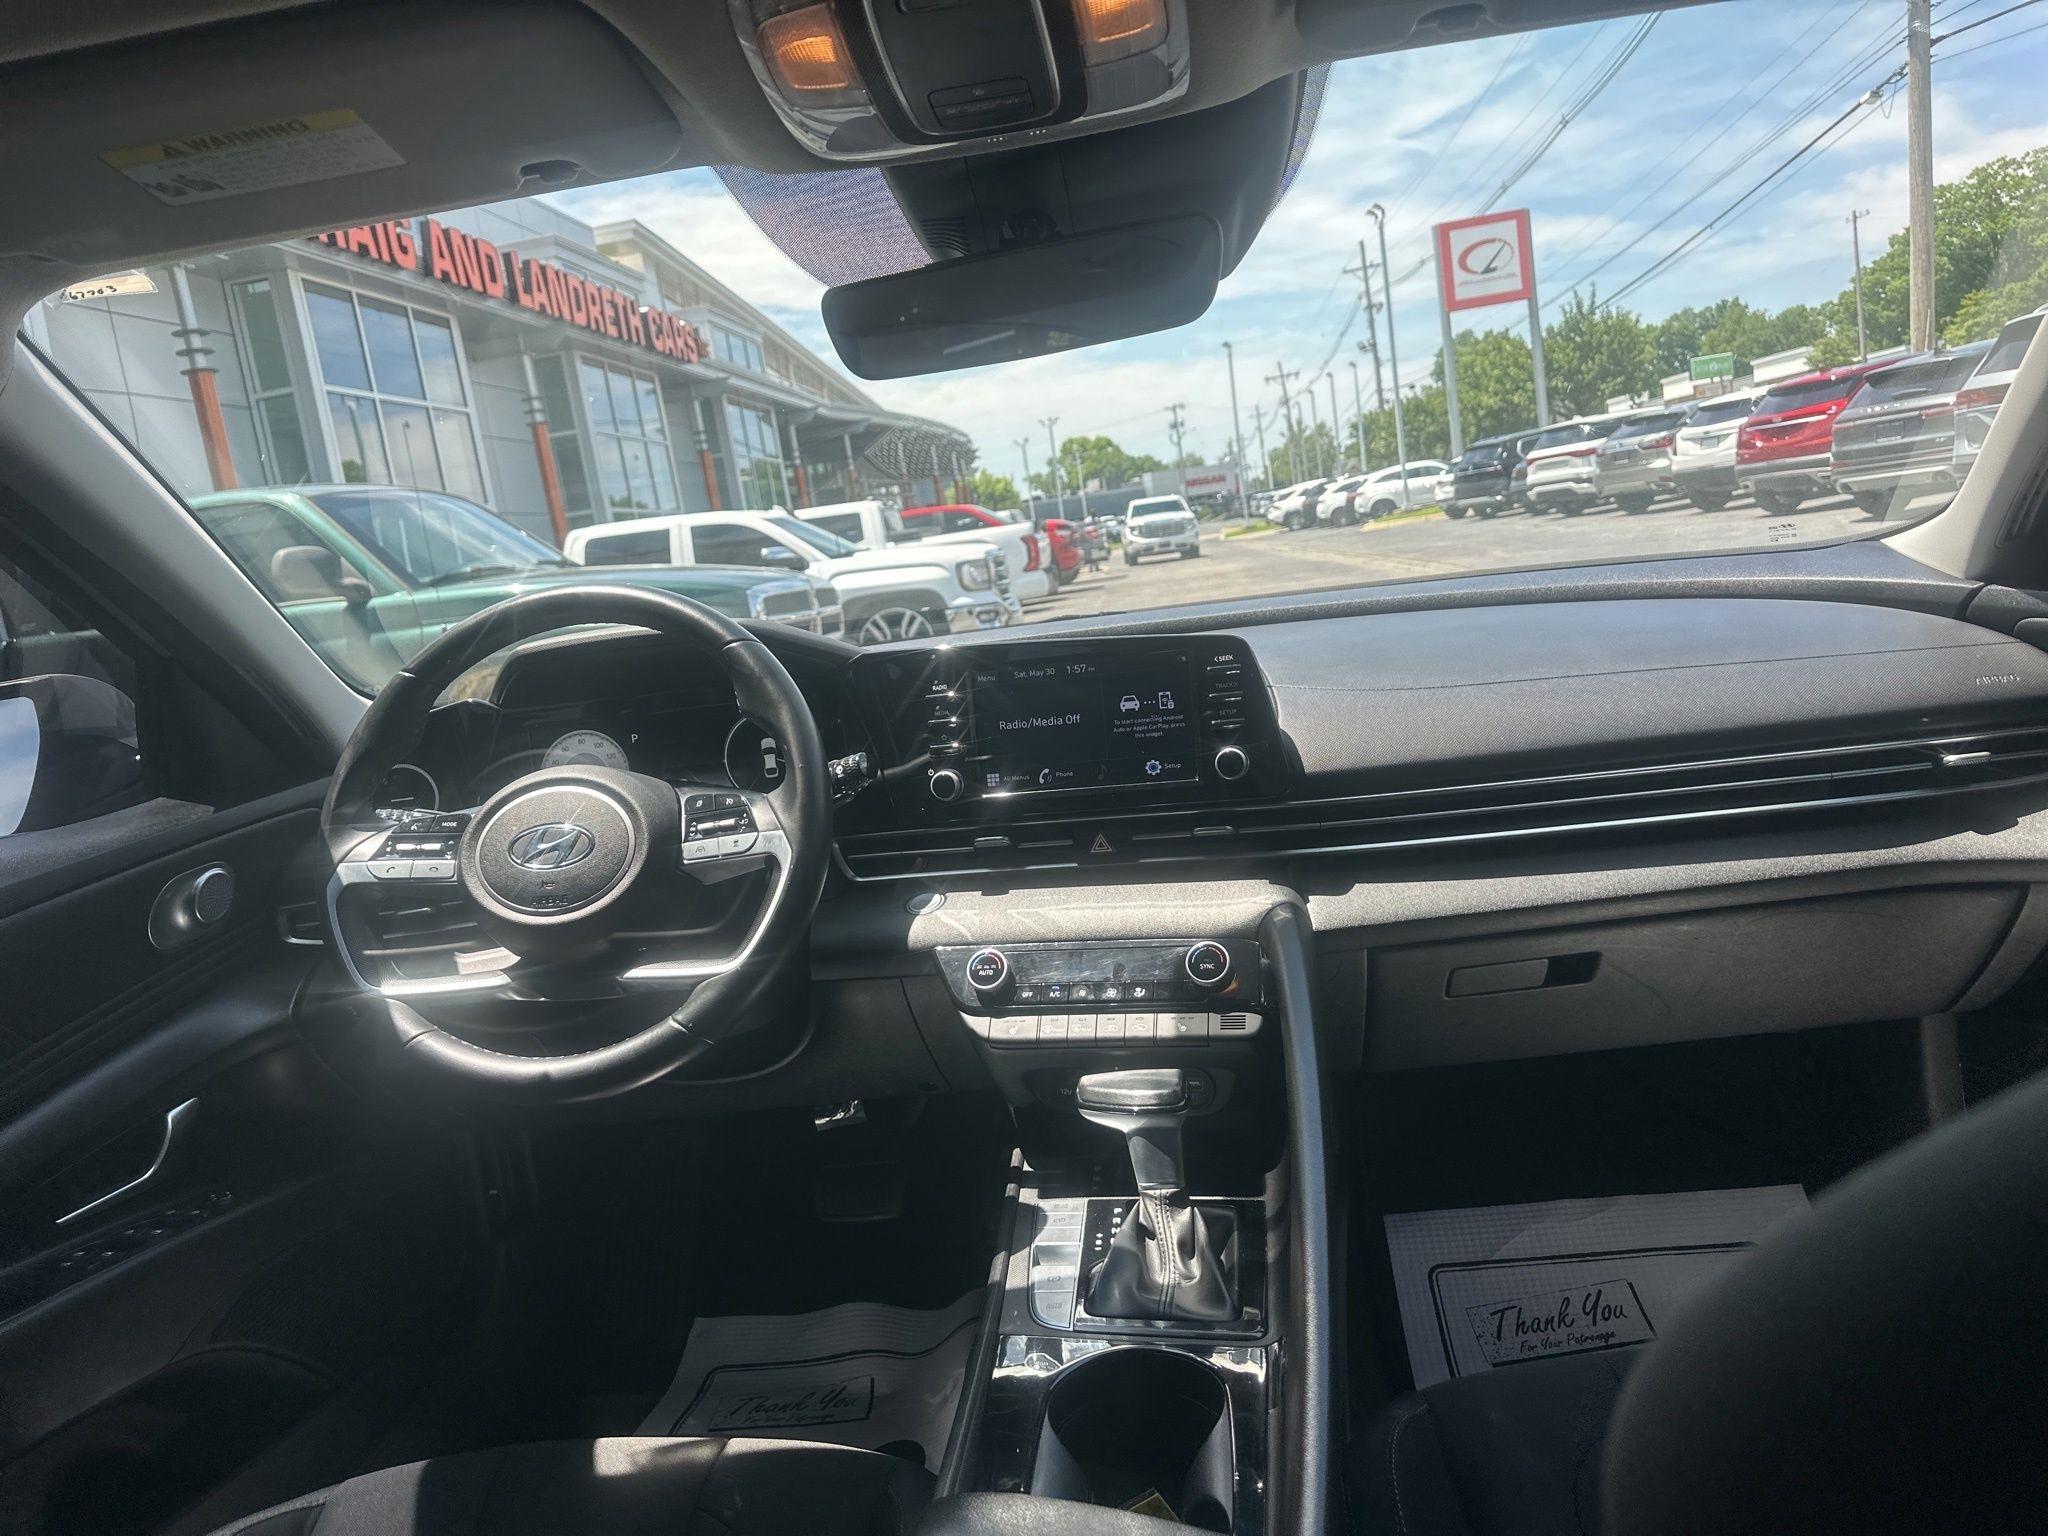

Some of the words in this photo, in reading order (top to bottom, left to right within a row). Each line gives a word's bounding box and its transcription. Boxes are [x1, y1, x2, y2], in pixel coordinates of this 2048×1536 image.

[182, 118, 311, 152] WARNING
[425, 218, 505, 299] AND
[511, 249, 646, 347] LANDRETH
[648, 306, 699, 364] CARS
[1029, 670, 1044, 678] May
[1045, 667, 1056, 676] 30
[1066, 664, 1086, 674] 1:57
[999, 716, 1063, 730] Radio/Media
[1065, 714, 1081, 725] Off
[1135, 716, 1162, 724] connecting
[631, 734, 639, 743] P
[1490, 1296, 1575, 1342] Thank
[1582, 1289, 1628, 1328] You
[1520, 1339, 1537, 1353] For
[1540, 1338, 1563, 1350] Your
[1567, 1331, 1617, 1347] Patronage
[729, 1391, 816, 1416] Thank
[820, 1385, 858, 1412] You
